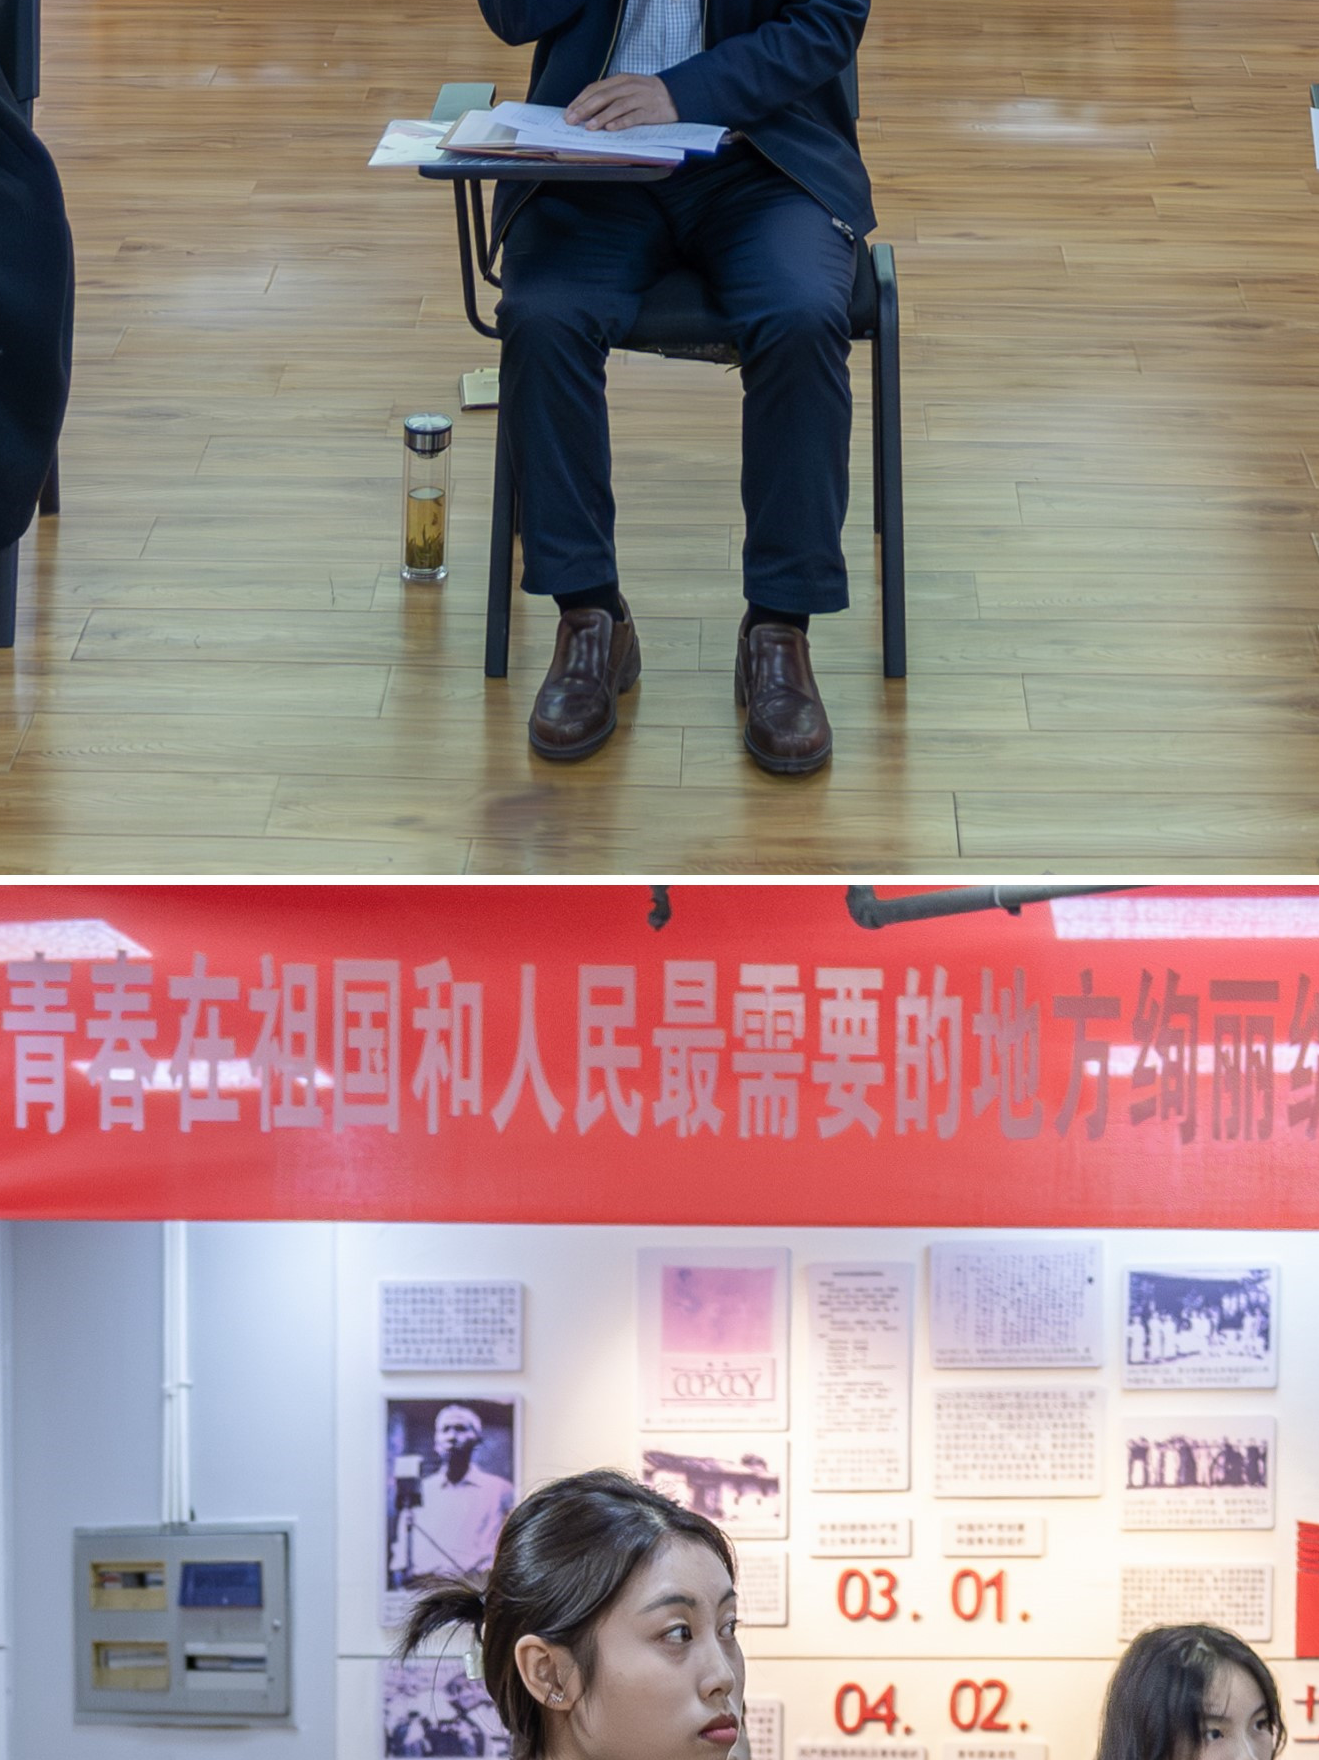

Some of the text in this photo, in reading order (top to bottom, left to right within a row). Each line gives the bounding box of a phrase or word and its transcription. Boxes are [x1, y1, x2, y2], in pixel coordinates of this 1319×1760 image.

[837, 1568, 921, 1622] 03.
[950, 1568, 1030, 1623] 01.
[833, 1681, 913, 1735] 04.
[949, 1678, 1029, 1733] 02.
